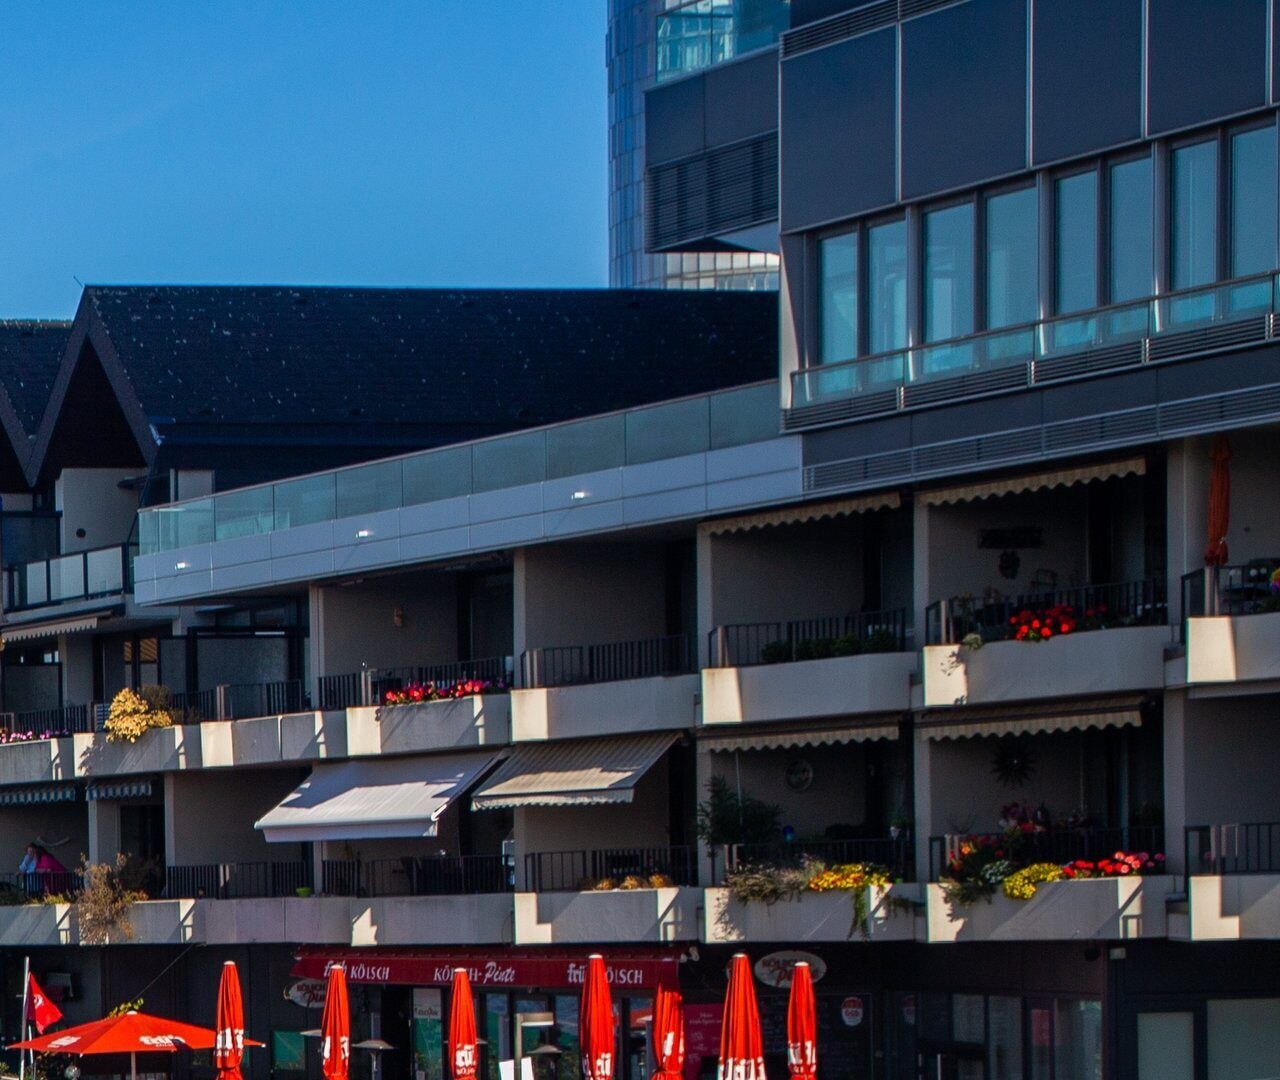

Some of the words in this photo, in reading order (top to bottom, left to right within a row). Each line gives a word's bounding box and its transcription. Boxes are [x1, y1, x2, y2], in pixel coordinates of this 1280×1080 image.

[350, 963, 390, 980] KÖLSCH
[483, 961, 516, 984] Pinte
[567, 963, 585, 983] frü
[606, 966, 643, 984] ÖLSCH
